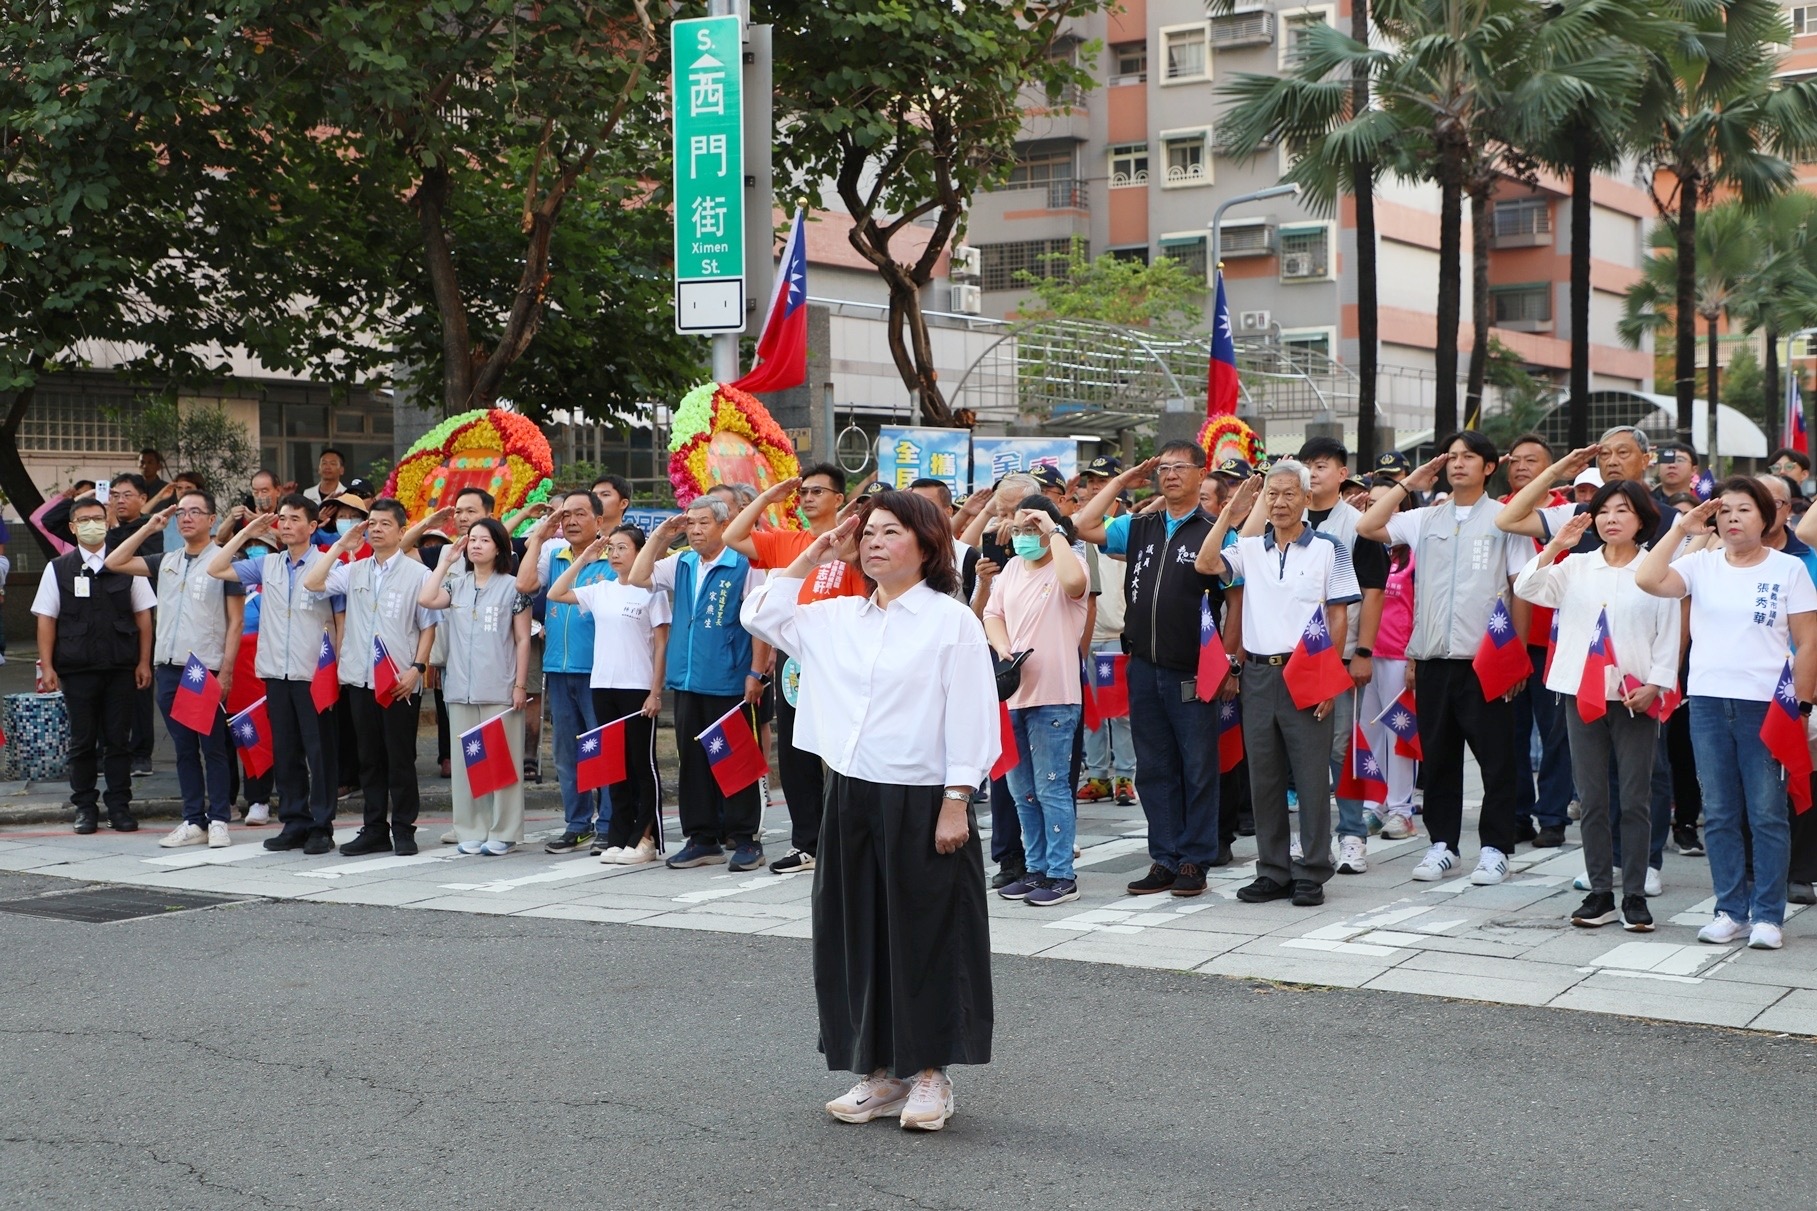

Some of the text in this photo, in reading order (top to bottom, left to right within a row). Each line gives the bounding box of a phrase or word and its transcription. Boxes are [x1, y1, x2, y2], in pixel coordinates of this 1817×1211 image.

[697, 29, 715, 50] S.
[688, 71, 727, 238] 西門街
[692, 242, 728, 254] Ximen
[701, 259, 720, 275] St.
[1753, 582, 1769, 624] 張秀華
[1766, 583, 1780, 627] 嘉義市議員
